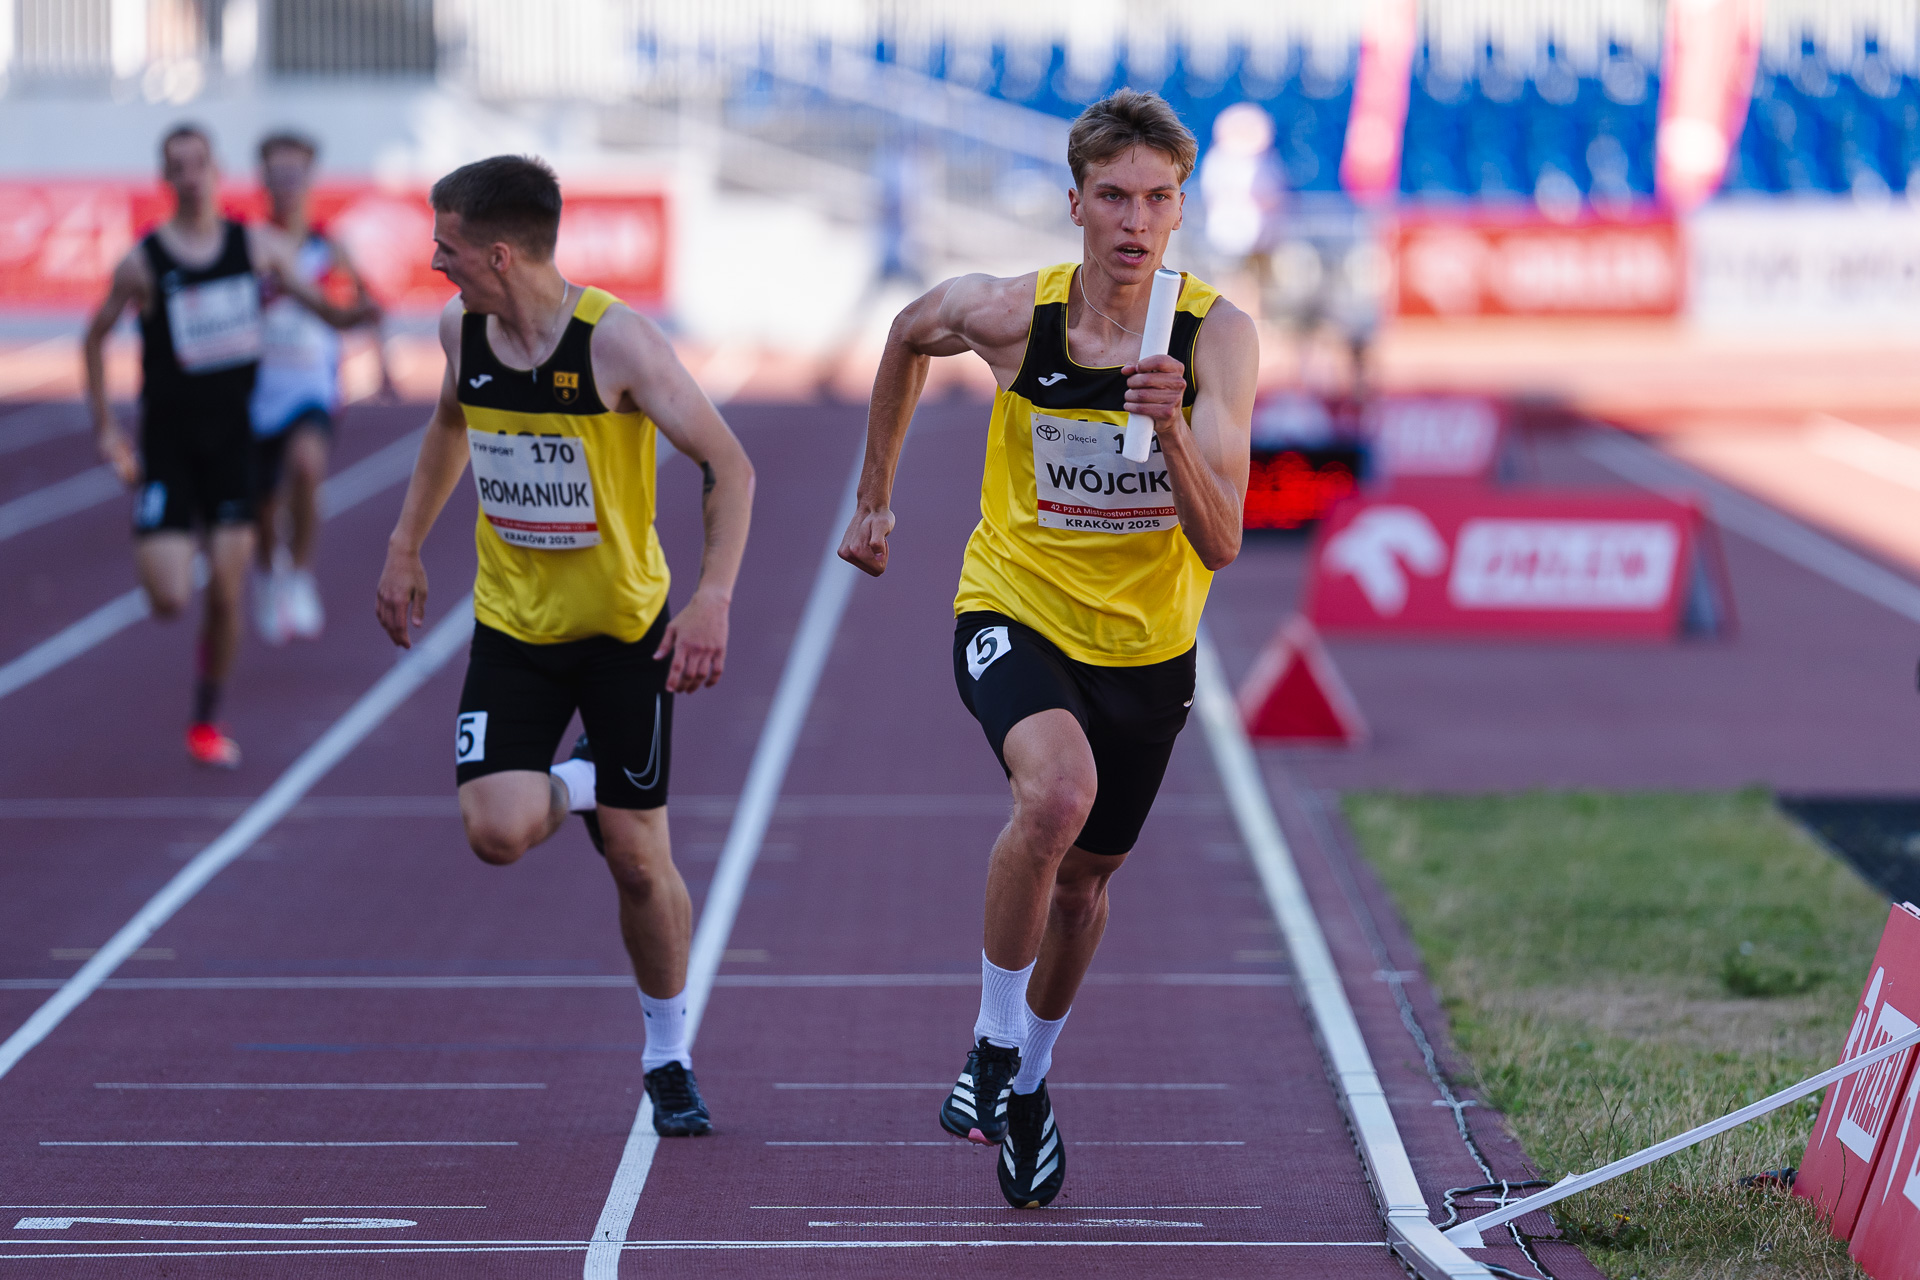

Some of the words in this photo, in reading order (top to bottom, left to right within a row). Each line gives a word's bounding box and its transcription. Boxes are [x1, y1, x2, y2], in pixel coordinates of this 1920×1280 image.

[1067, 434, 1097, 444] Okęcie
[1113, 433, 1162, 454] 11
[489, 446, 514, 456] SPORT
[531, 442, 575, 463] 170
[1046, 462, 1172, 496] WÓJCIK
[479, 477, 589, 508] ROMANIUK
[1050, 503, 1062, 512] 42.
[1063, 506, 1082, 514] PZLA
[1083, 508, 1132, 517] Mistrzostwa
[1065, 518, 1124, 531] KRAKÓW
[1127, 519, 1160, 529] 2025
[504, 531, 546, 544] KRAKÓW
[548, 535, 576, 544] 2025
[975, 628, 998, 665] 5
[459, 717, 475, 757] 5
